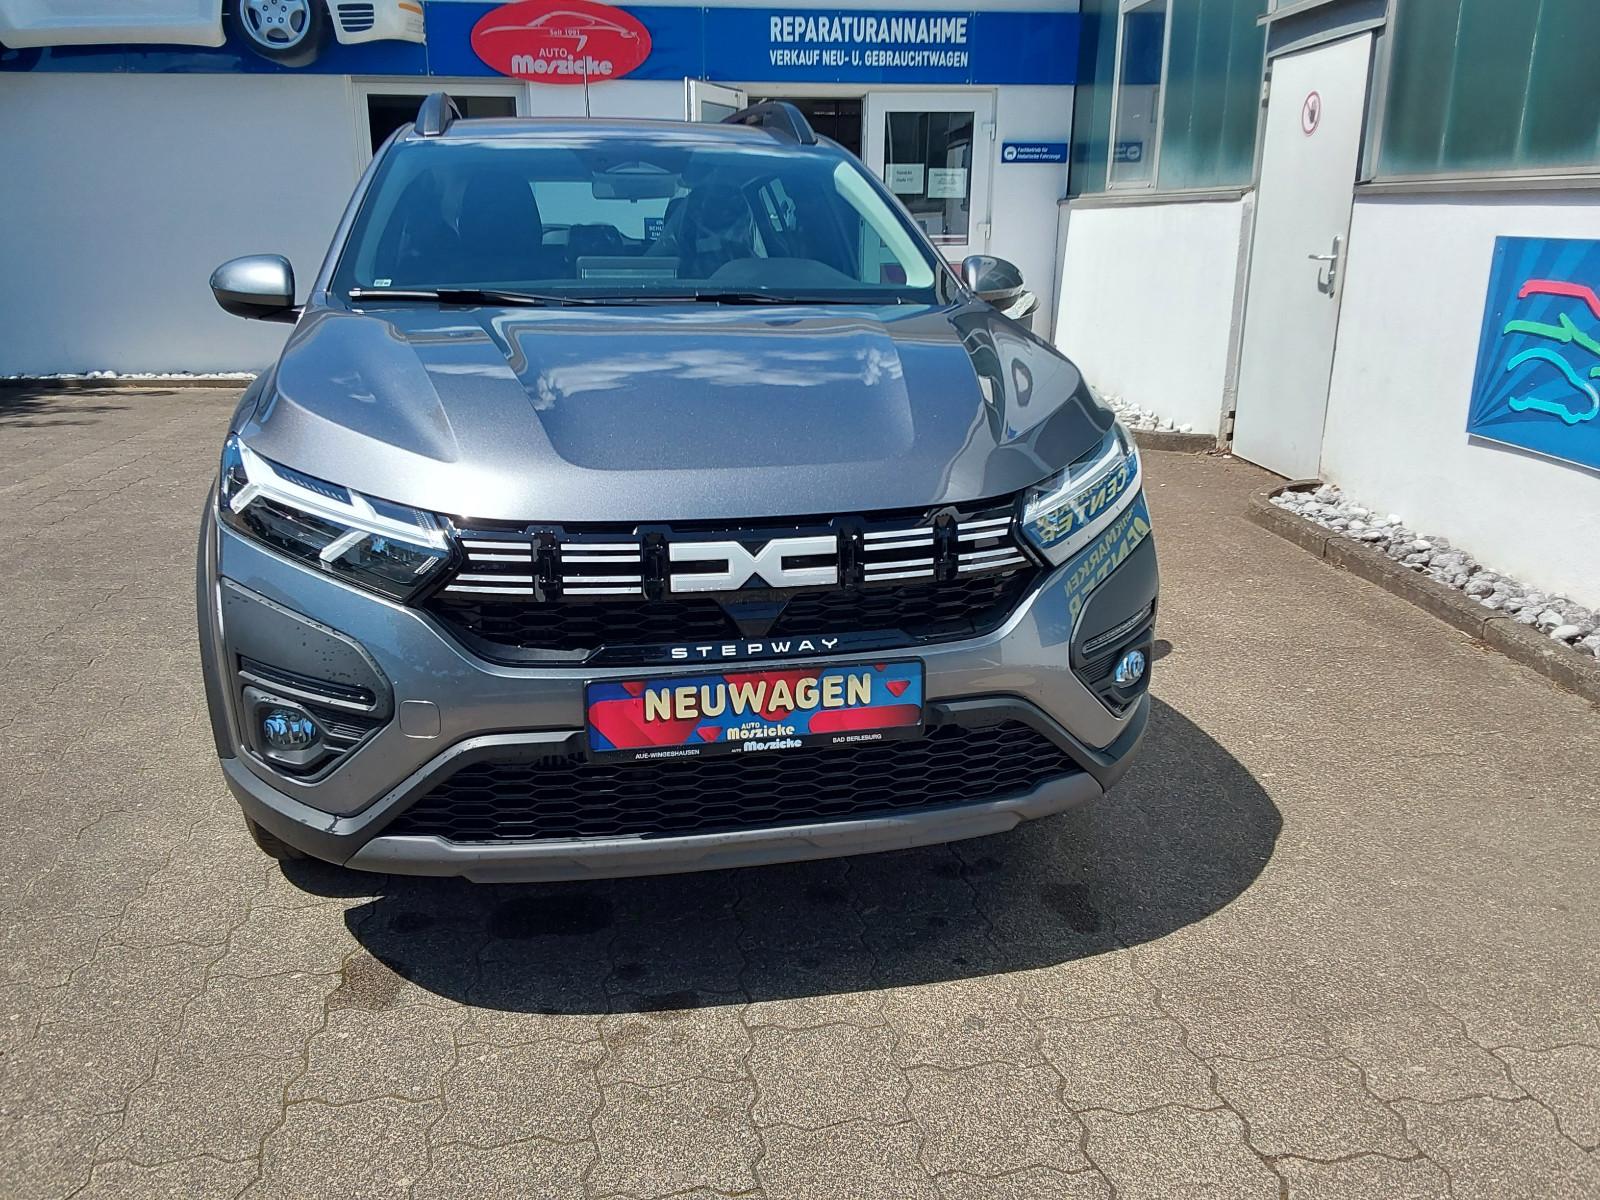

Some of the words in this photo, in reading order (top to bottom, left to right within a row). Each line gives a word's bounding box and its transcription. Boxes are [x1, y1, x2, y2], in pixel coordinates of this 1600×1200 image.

[770, 16, 968, 44] REPARATURANNAHME
[539, 48, 568, 58] AUTO
[770, 49, 820, 66] VERKAUF
[822, 50, 850, 66] NEU-
[852, 50, 862, 66] U.
[864, 50, 969, 67] GEBRAUCHTWAGEN
[511, 54, 614, 75] Moszicke
[671, 638, 838, 659] STEPWAY
[644, 672, 873, 722] NEUWAGEN
[727, 724, 796, 741] Moszicke
[741, 722, 760, 730] AUTO
[743, 738, 803, 752] Moszicke
[832, 736, 845, 744] BAD
[846, 733, 882, 742] BERLEBURG
